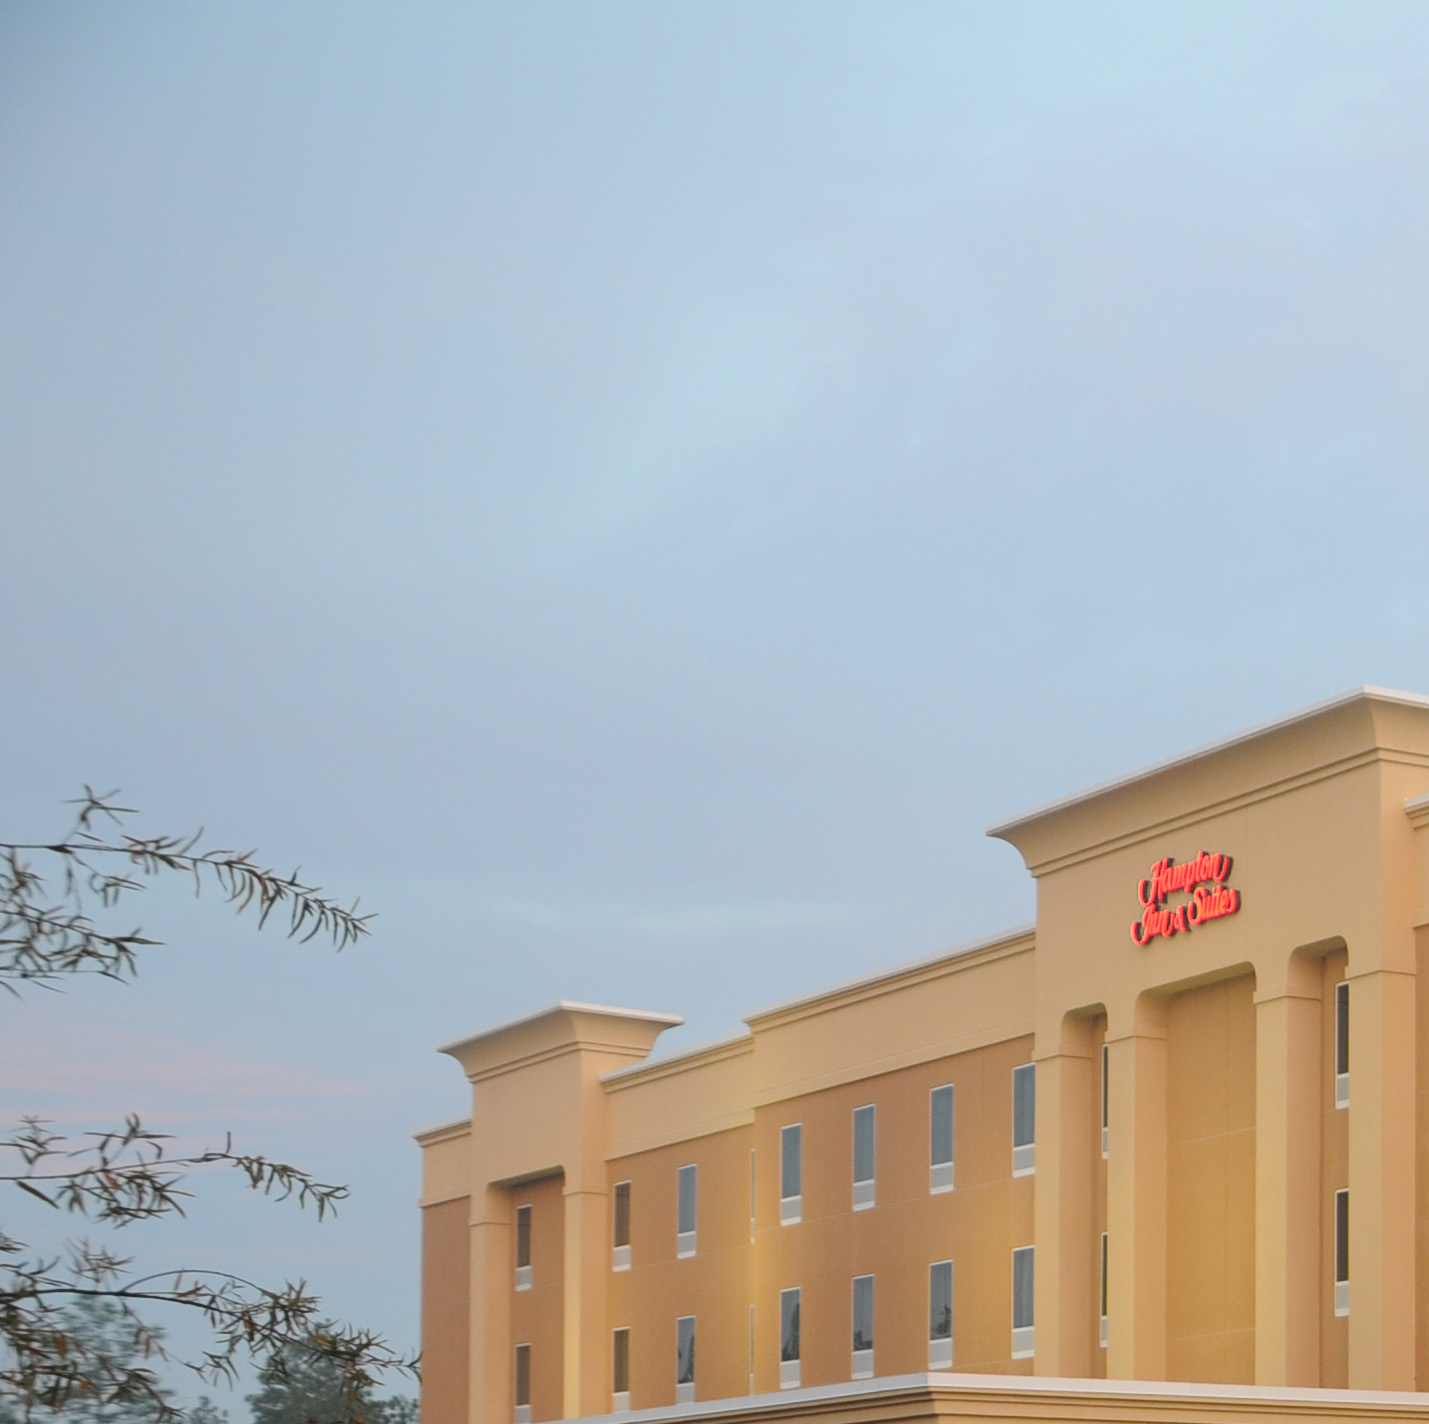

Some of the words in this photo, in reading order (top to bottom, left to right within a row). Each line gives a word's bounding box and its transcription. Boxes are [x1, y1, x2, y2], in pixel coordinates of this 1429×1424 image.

[1137, 850, 1230, 907] Hampton
[1130, 903, 1176, 946] Inn
[1187, 885, 1238, 926] Suites
